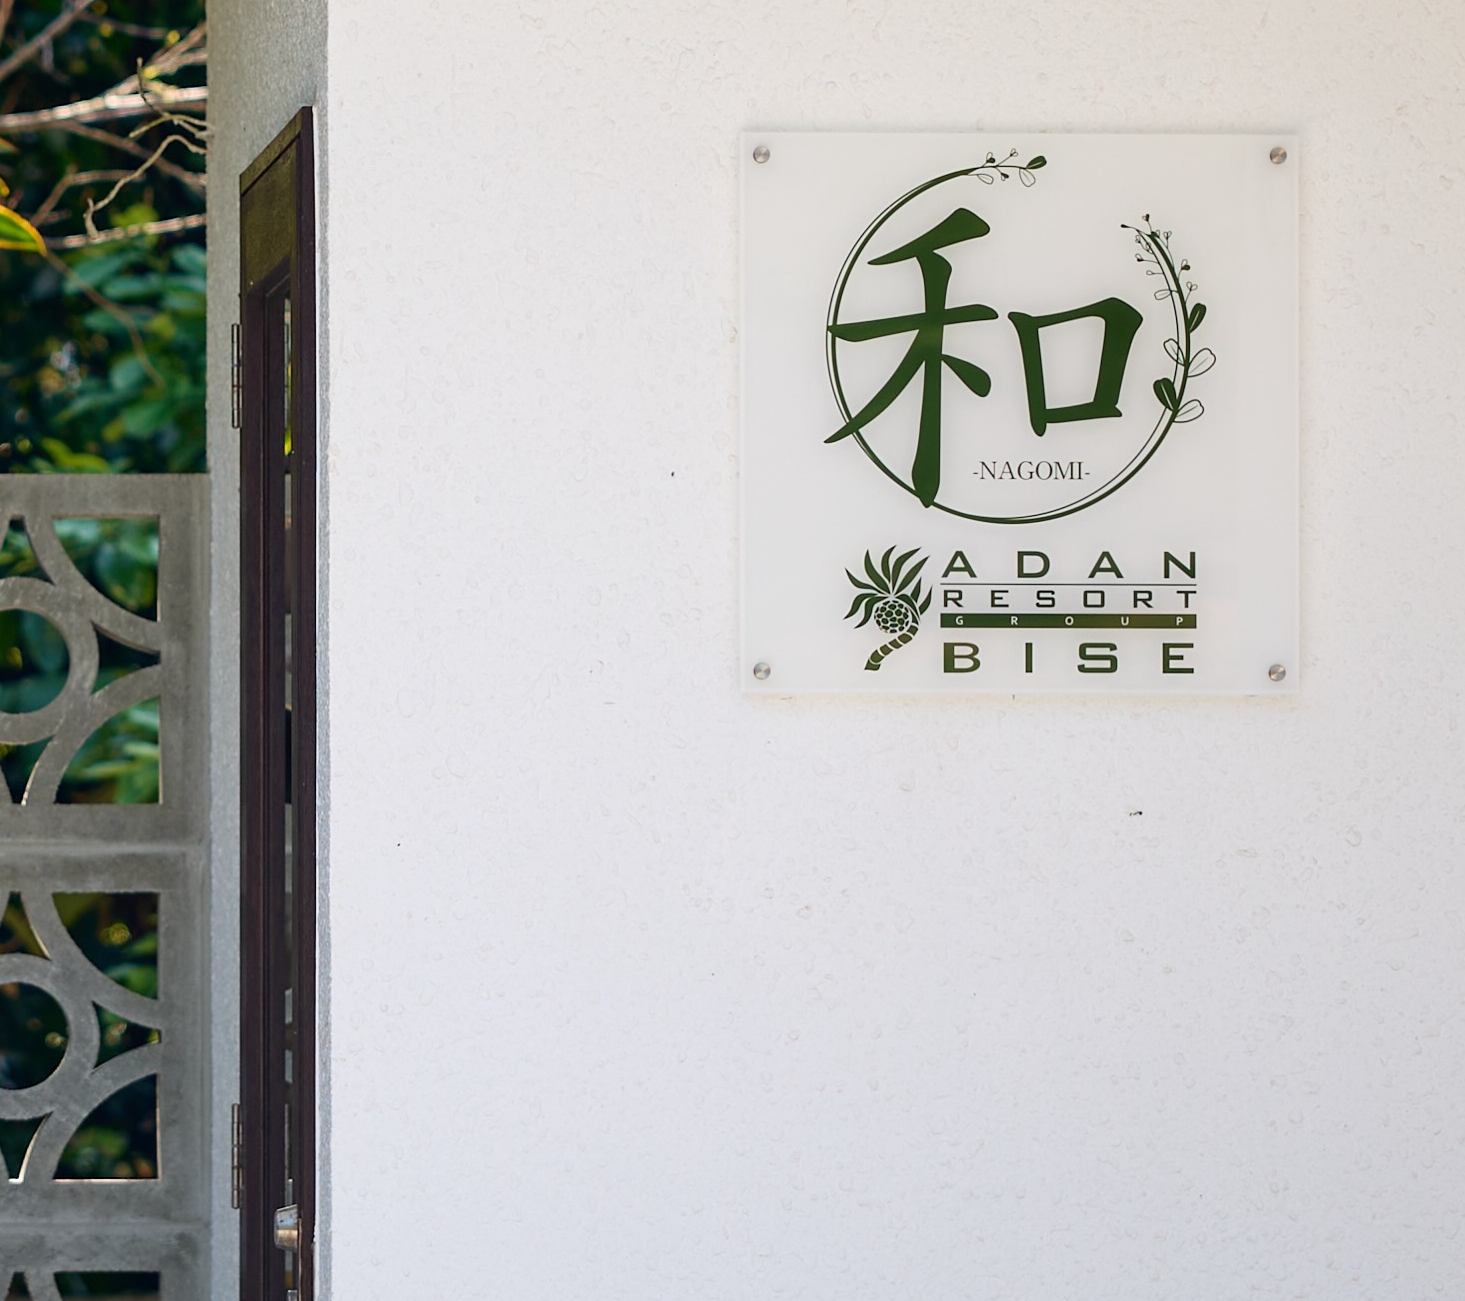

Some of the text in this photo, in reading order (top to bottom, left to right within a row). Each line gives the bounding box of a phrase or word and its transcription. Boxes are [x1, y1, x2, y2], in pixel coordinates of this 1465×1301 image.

[823, 207, 1144, 509] 和
[941, 549, 1197, 579] ADAN
[942, 589, 1198, 609] RESORT
[954, 615, 1185, 626] GROUP
[942, 641, 1195, 674] BISE
